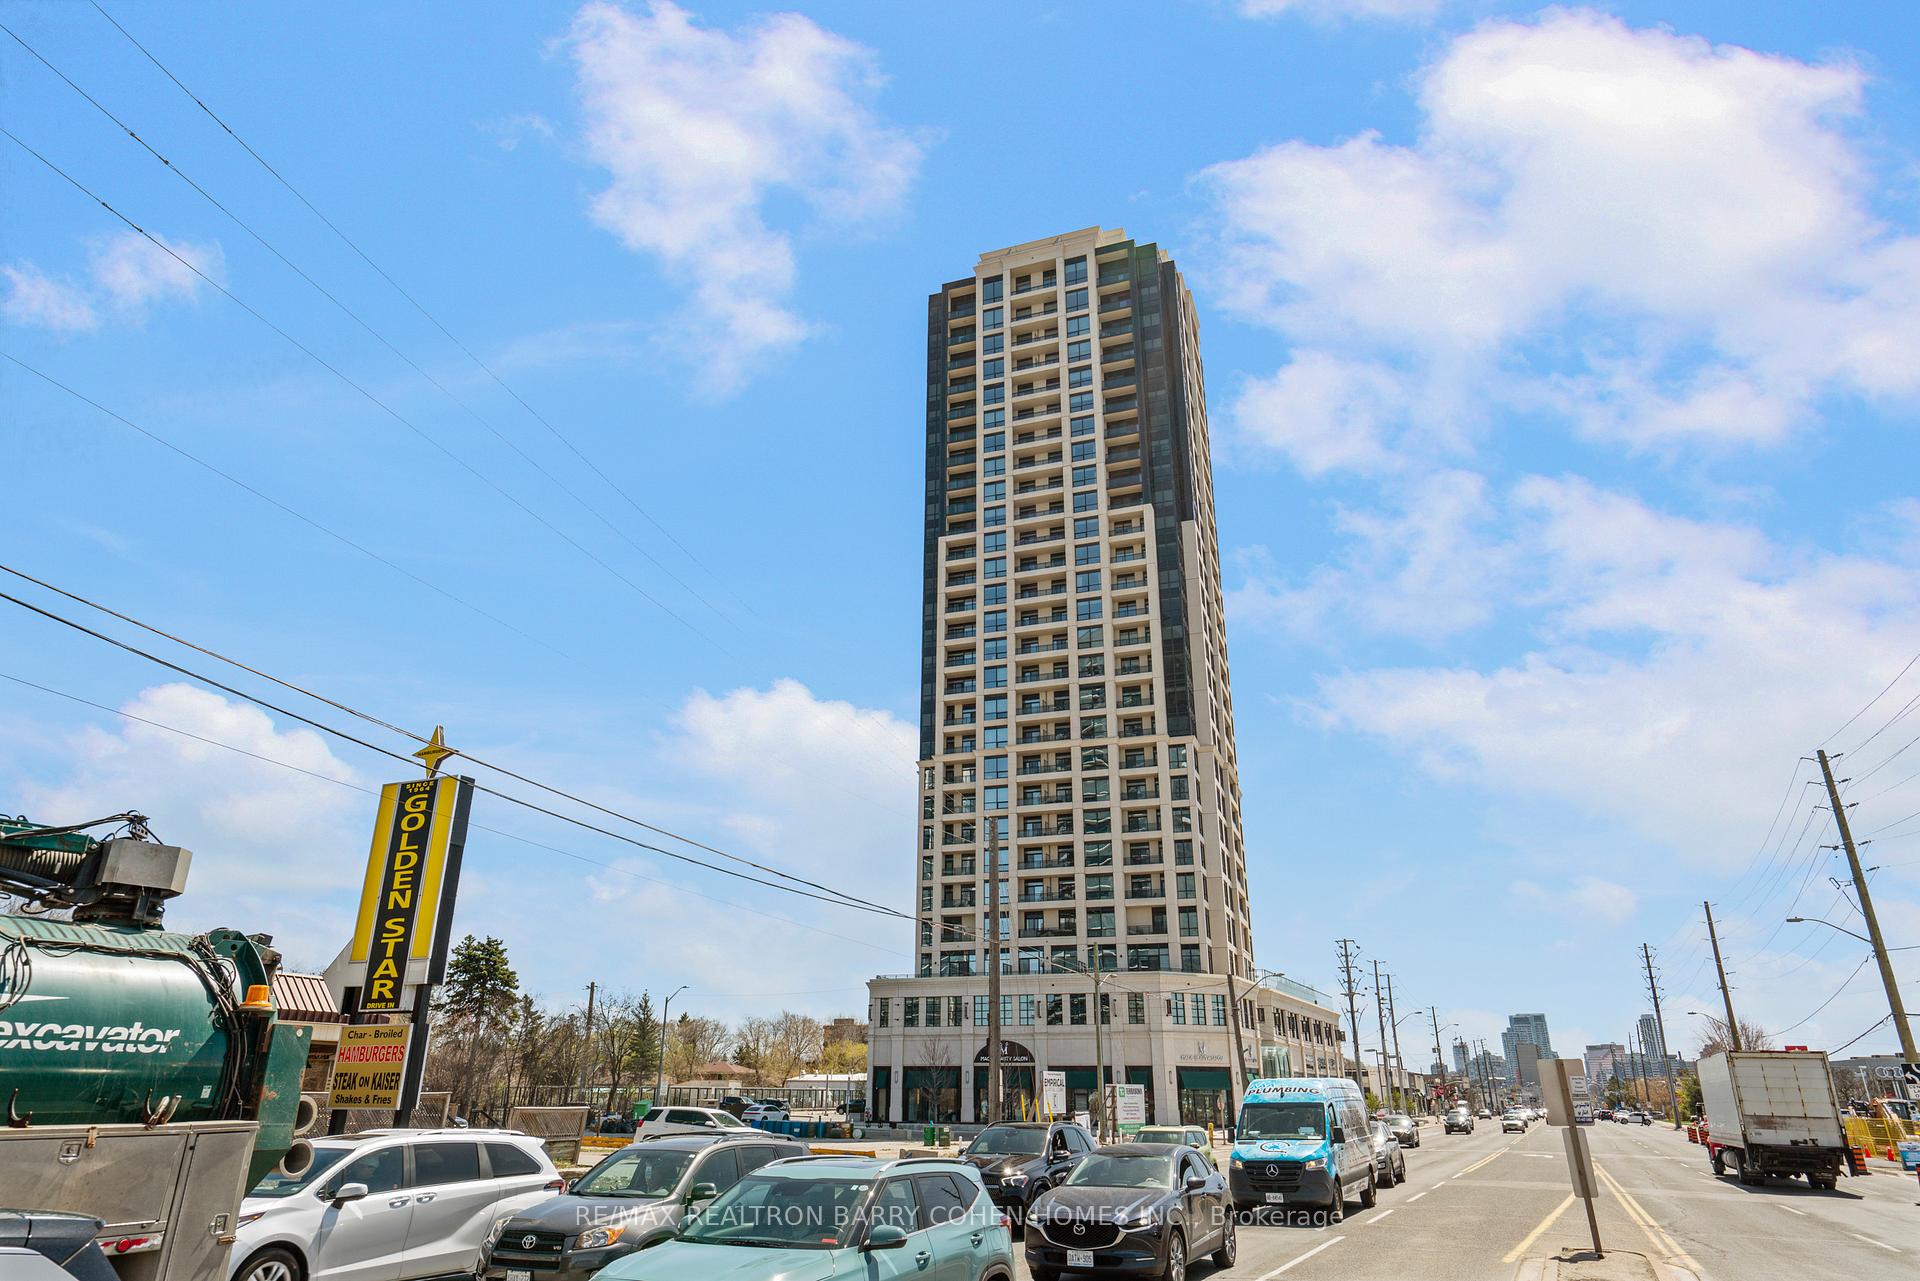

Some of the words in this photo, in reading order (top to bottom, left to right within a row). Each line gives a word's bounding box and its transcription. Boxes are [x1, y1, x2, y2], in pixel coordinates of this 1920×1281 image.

[406, 781, 434, 789] SINCE
[387, 794, 429, 910] GOLDEN
[371, 917, 406, 1000] STAR
[348, 1030, 367, 1039] Char
[374, 1029, 403, 1039] Broiled
[338, 1045, 405, 1063] HAMBURGERS
[333, 1072, 358, 1090] STEAK
[371, 1072, 401, 1090] KAISER
[1247, 1087, 1319, 1096] PLUMBING
[335, 1095, 361, 1104] Shakes
[364, 1095, 370, 1104] &
[372, 1095, 392, 1104] Fries
